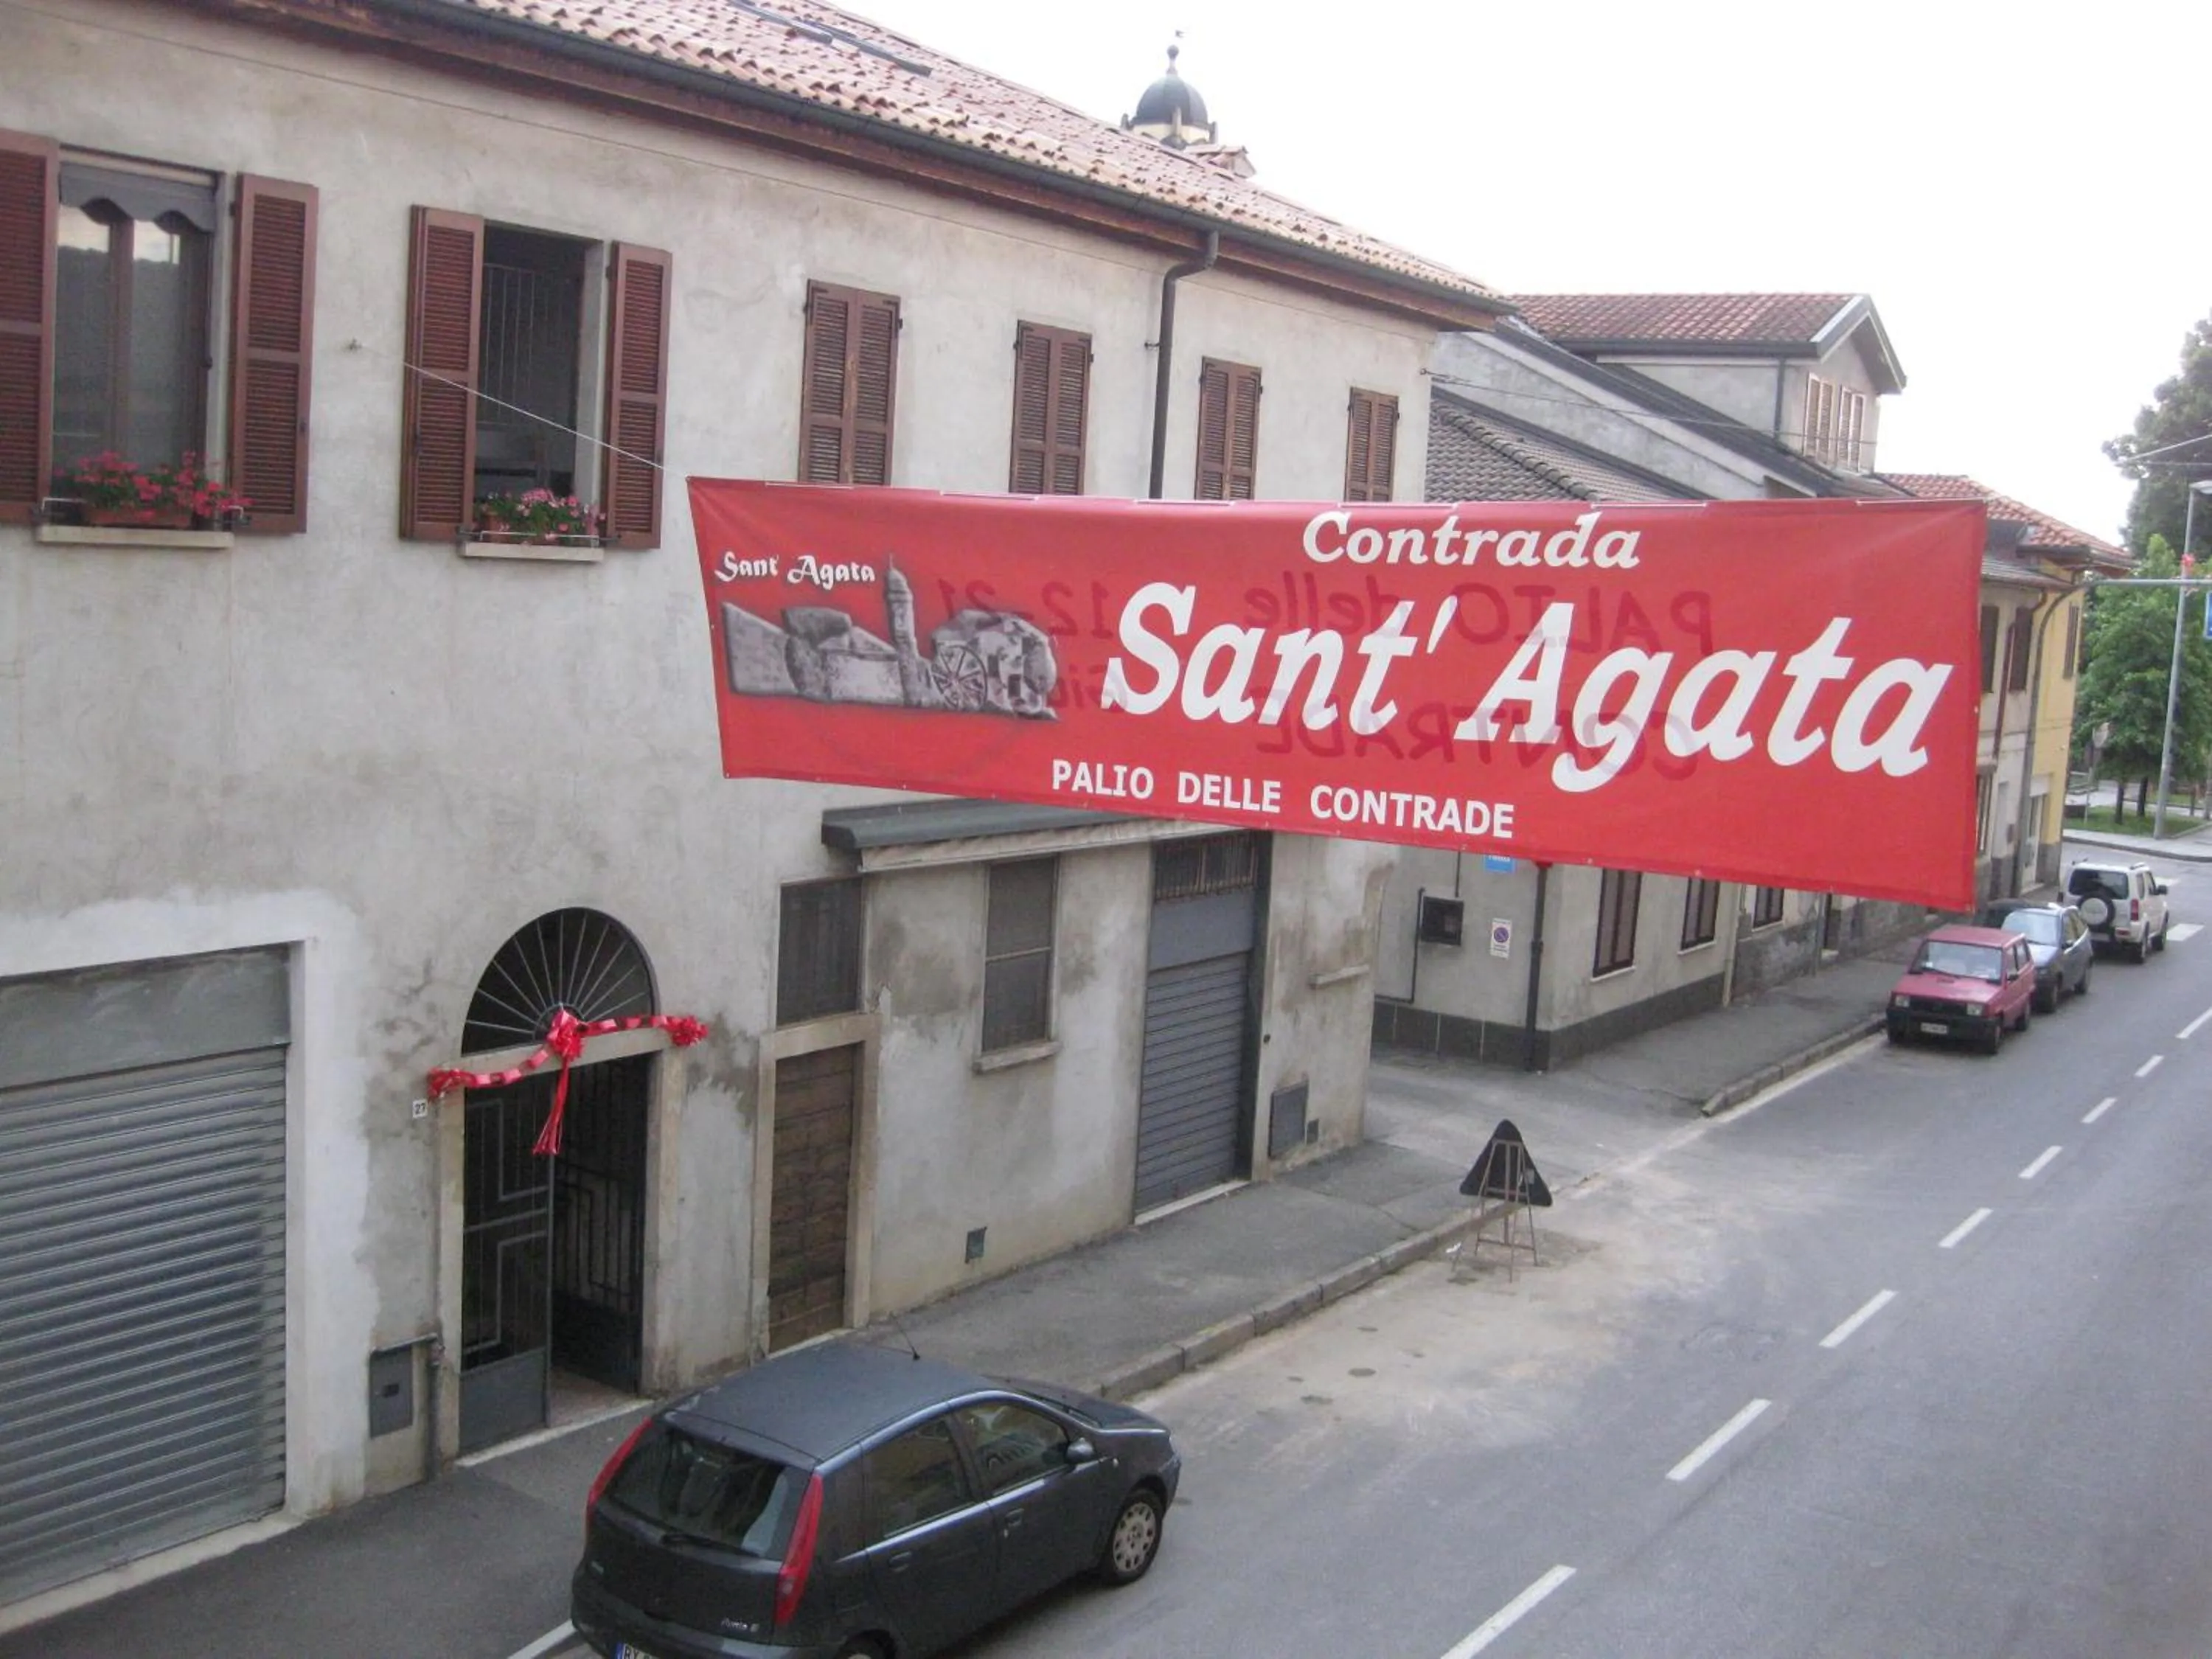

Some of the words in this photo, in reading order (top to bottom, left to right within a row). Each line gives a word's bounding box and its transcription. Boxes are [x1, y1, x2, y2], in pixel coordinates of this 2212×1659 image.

[786, 554, 876, 591] Agata
[1302, 511, 1641, 569] Contrada
[1100, 581, 1458, 736] Sant'
[1453, 601, 1954, 793] Agata
[1051, 759, 1155, 799] PALIO
[1178, 771, 1281, 813] DELLE
[1310, 785, 1515, 839] CONTRADE
